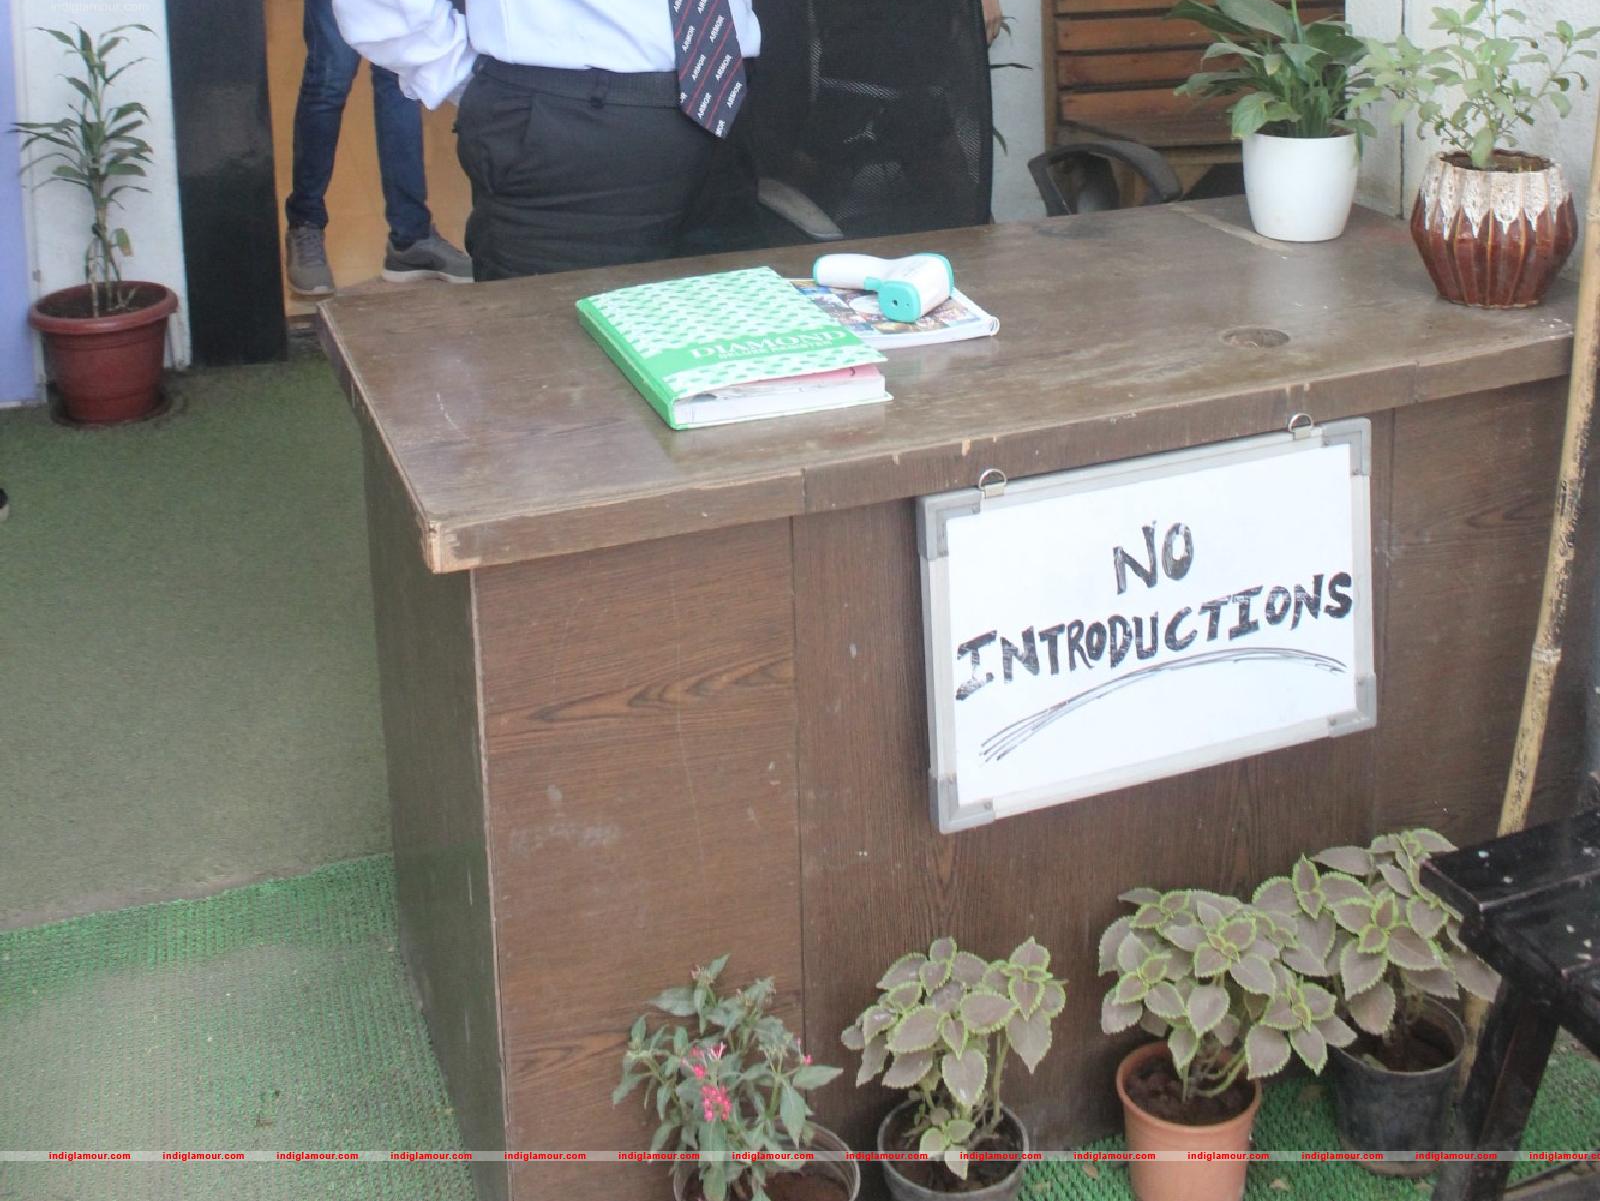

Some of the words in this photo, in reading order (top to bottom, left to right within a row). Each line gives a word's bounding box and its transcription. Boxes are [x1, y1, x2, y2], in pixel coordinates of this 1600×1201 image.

[690, 330, 847, 359] DIAMOND
[1112, 520, 1194, 595] NO
[955, 571, 1353, 701] INTRODUCTIONS
